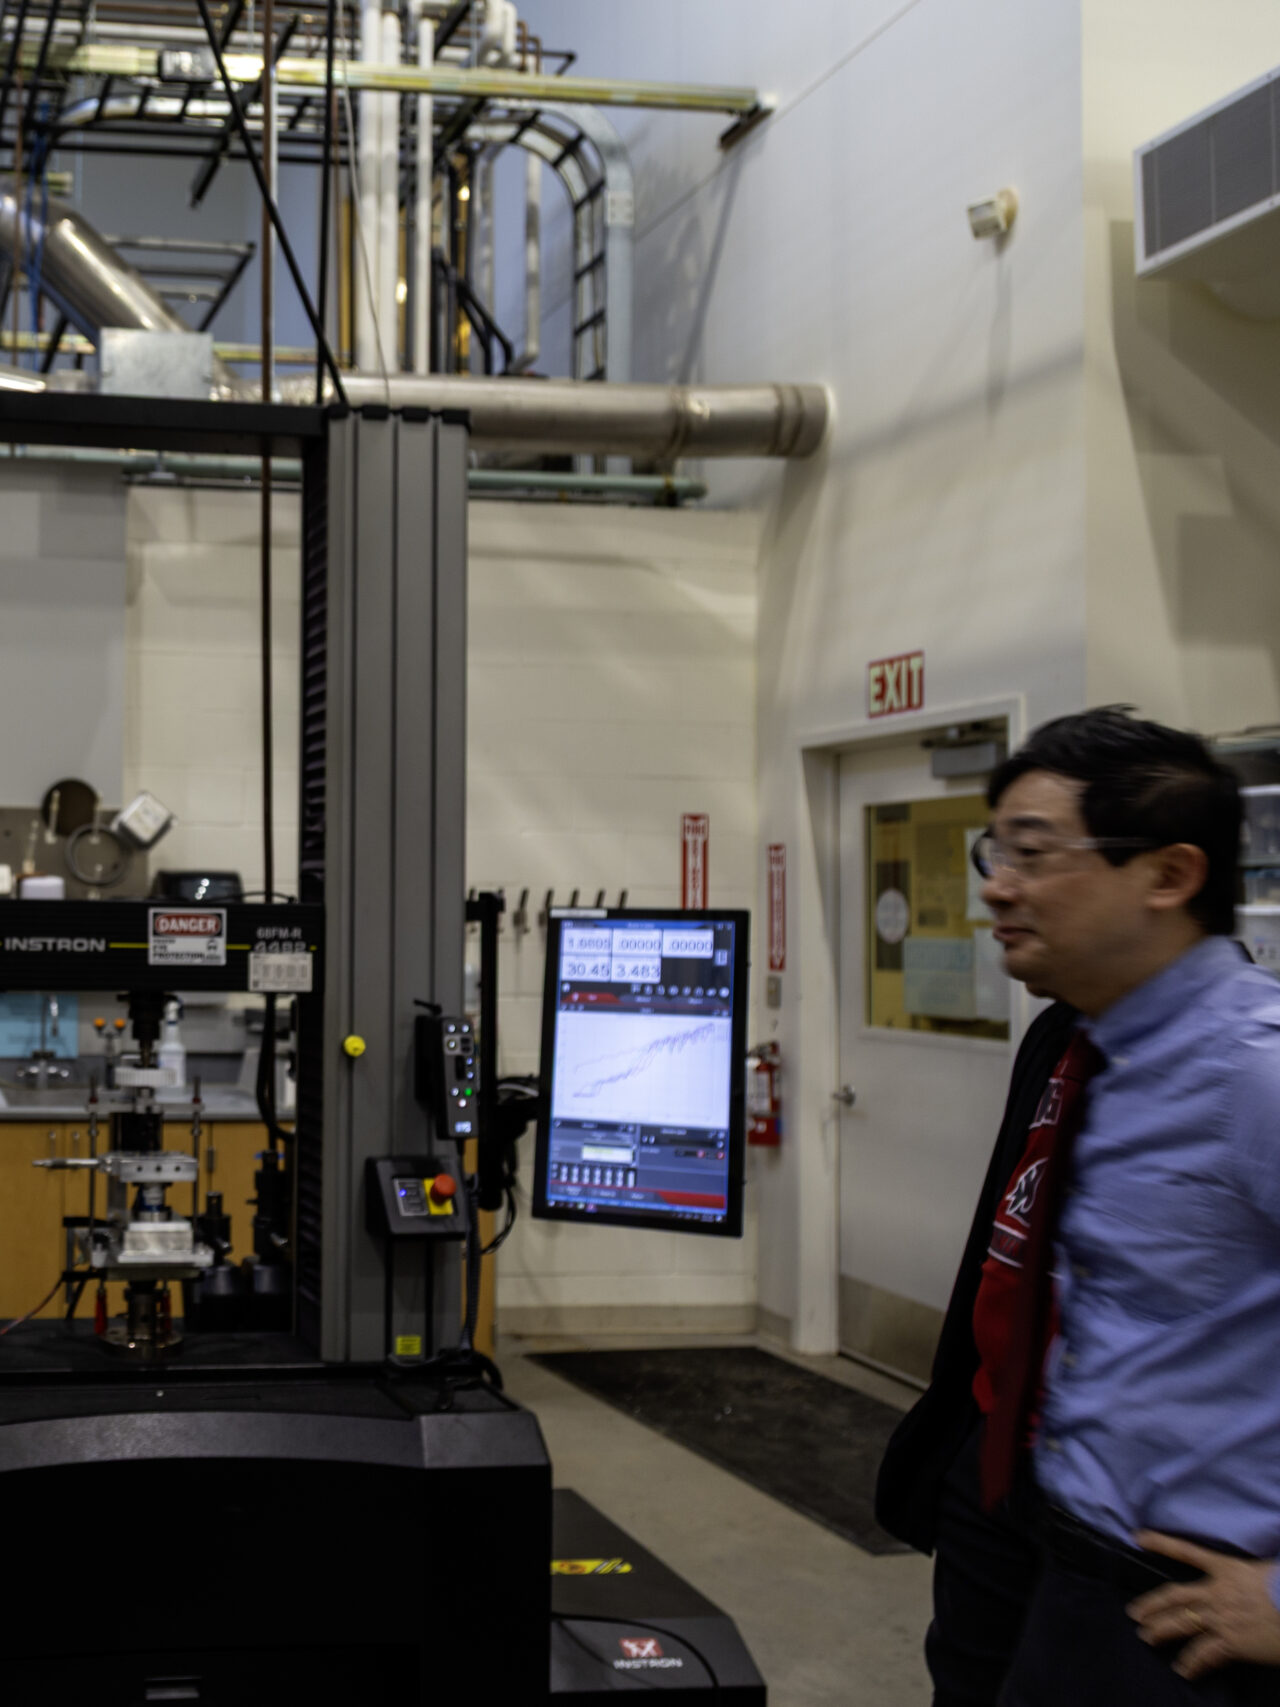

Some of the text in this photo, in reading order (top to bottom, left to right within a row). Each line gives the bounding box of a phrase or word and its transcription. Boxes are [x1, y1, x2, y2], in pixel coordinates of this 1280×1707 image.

[870, 657, 922, 713] EXIT
[158, 917, 217, 932] DANGER
[4, 936, 106, 952] INSTRON
[614, 1657, 682, 1669] INSTRON
